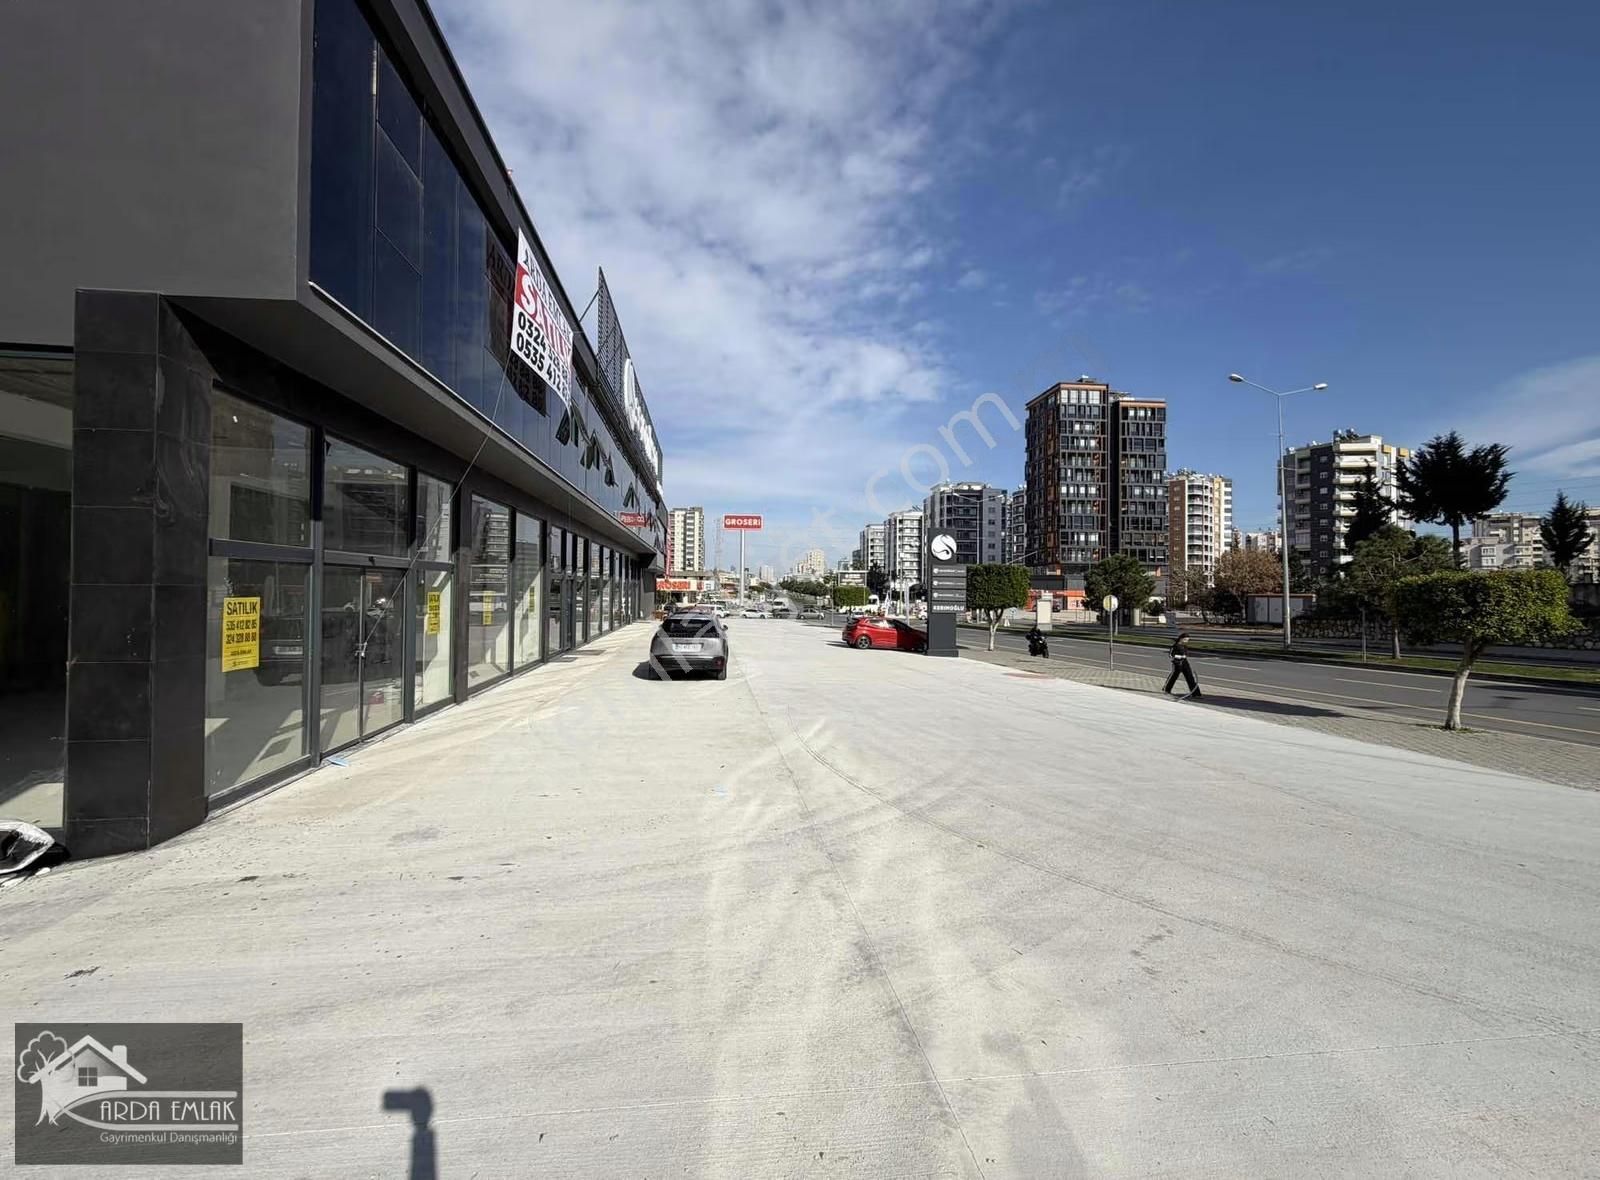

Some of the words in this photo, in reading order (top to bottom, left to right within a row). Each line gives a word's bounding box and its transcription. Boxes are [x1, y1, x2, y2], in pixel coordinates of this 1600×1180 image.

[518, 311, 546, 352] 0324
[516, 332, 545, 371] 0535
[546, 363, 561, 391] 412
[226, 602, 257, 615] SATILIK
